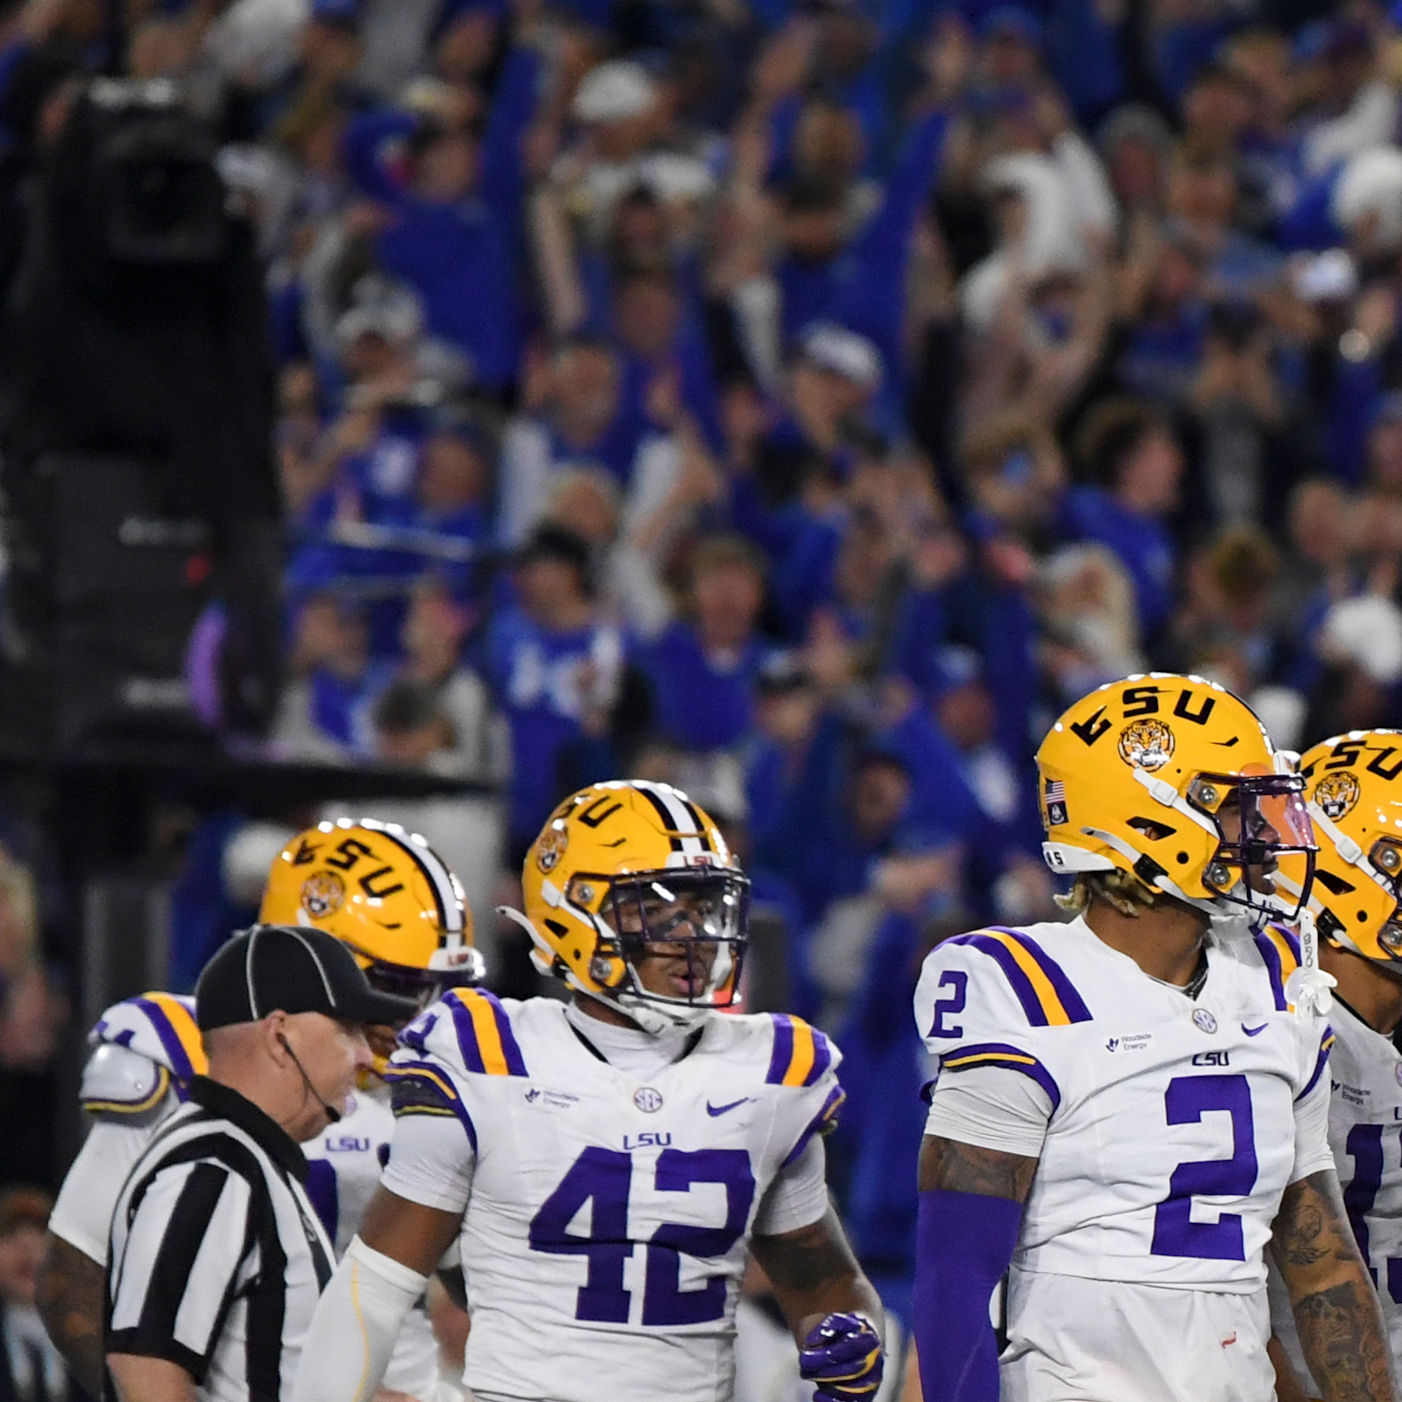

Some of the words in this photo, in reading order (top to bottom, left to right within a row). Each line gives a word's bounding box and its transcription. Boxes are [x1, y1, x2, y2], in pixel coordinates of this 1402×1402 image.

[1070, 686, 1217, 747] LSU
[291, 837, 404, 899] LSU
[927, 970, 968, 1039] 2
[1191, 1051, 1230, 1067] LSU
[325, 1138, 370, 1152] LSU
[623, 1132, 672, 1150] LSU
[1150, 1074, 1258, 1261] 2
[528, 1145, 756, 1327] 42
